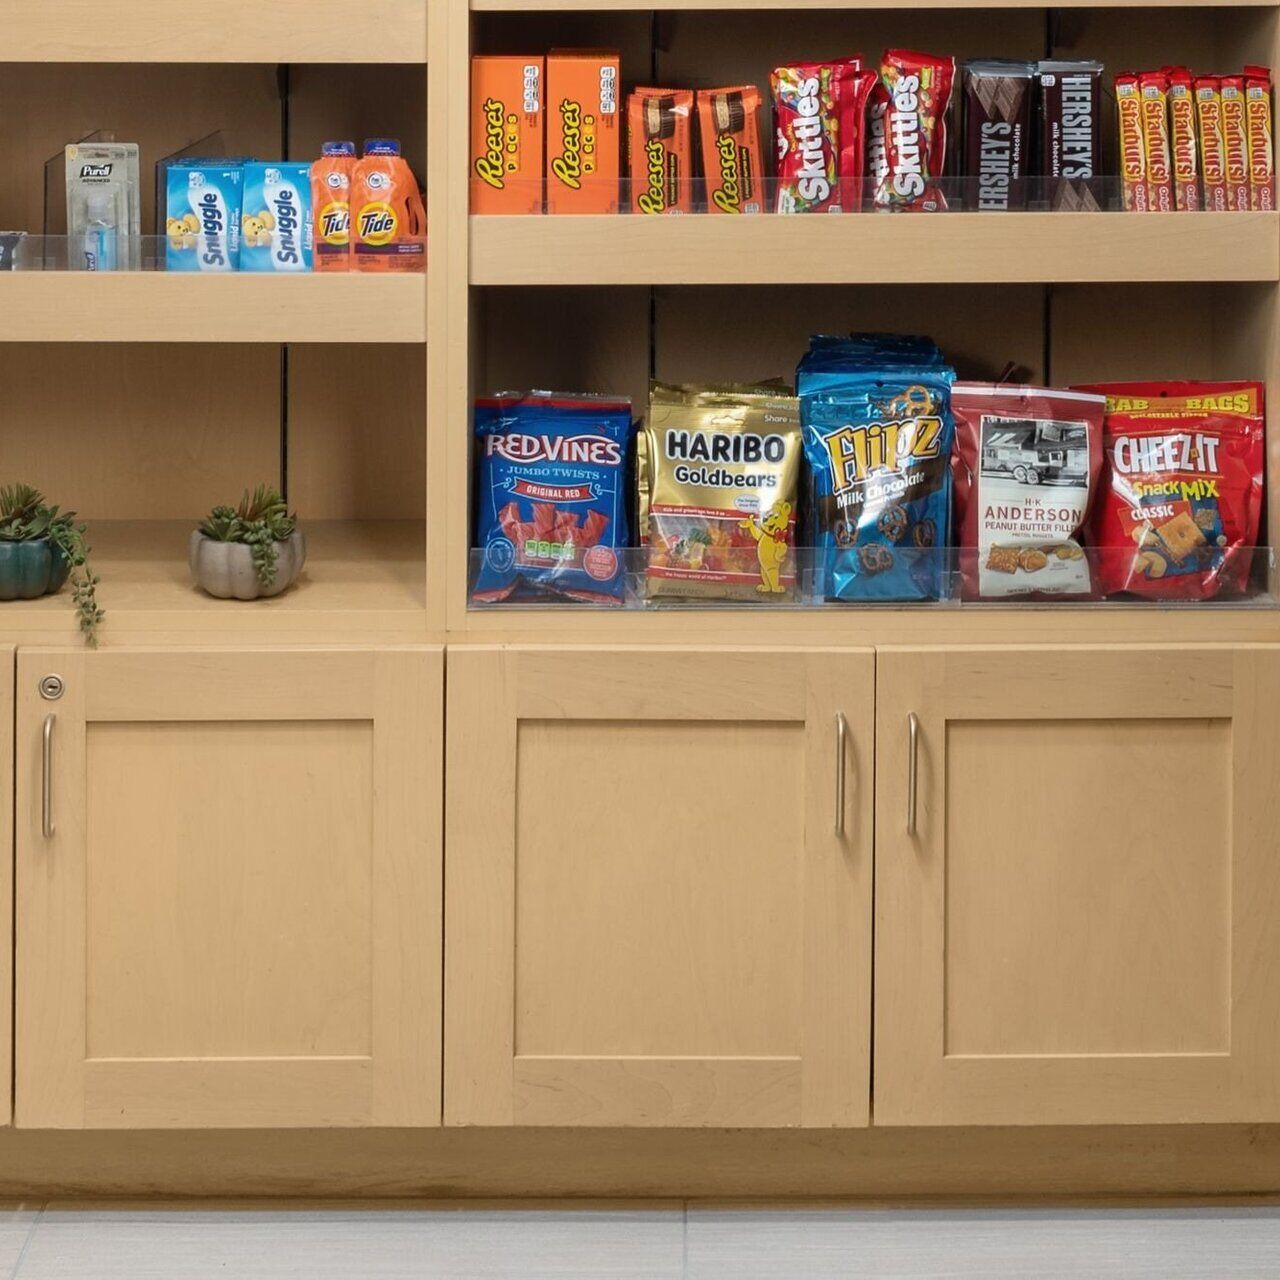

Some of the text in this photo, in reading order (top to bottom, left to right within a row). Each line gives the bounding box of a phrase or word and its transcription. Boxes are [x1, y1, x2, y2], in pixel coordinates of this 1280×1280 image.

[476, 98, 505, 189] Reese's
[552, 98, 581, 189] Reese's
[793, 77, 830, 201] Skittles
[891, 75, 924, 196] Skittles
[979, 122, 1011, 210] ERSHEY'S
[1061, 77, 1092, 180] HERSHEY'S
[1121, 100, 1143, 180] Starburst
[1145, 102, 1169, 181] Starburst
[1173, 100, 1196, 180] Starburst
[1201, 103, 1223, 183] Starburst
[1224, 103, 1247, 182] Starburst
[1250, 102, 1270, 182] Starburst
[638, 138, 666, 214] Reese's
[713, 133, 741, 214] Reese's
[199, 193, 224, 266] Snuggle
[229, 225, 238, 252] Liquid
[274, 190, 298, 264] Snuggle
[361, 212, 394, 236] Tide
[764, 414, 787, 423] Share
[1105, 394, 1250, 412] RAB BAGS
[507, 466, 600, 480] JUMBO TWISTS
[668, 431, 785, 464] HARIBO
[675, 467, 777, 489] Goldbears
[825, 417, 942, 495] Flipz
[526, 485, 580, 498] ORIGINAL RED
[837, 491, 864, 509] Milk
[866, 470, 925, 499] Chocolate
[985, 506, 1082, 523] ANDERSON
[985, 522, 1018, 531] PEANUT
[1020, 523, 1052, 532] BUTTER
[1131, 504, 1174, 521] CLASSIC
[1133, 481, 1179, 499] Snack
